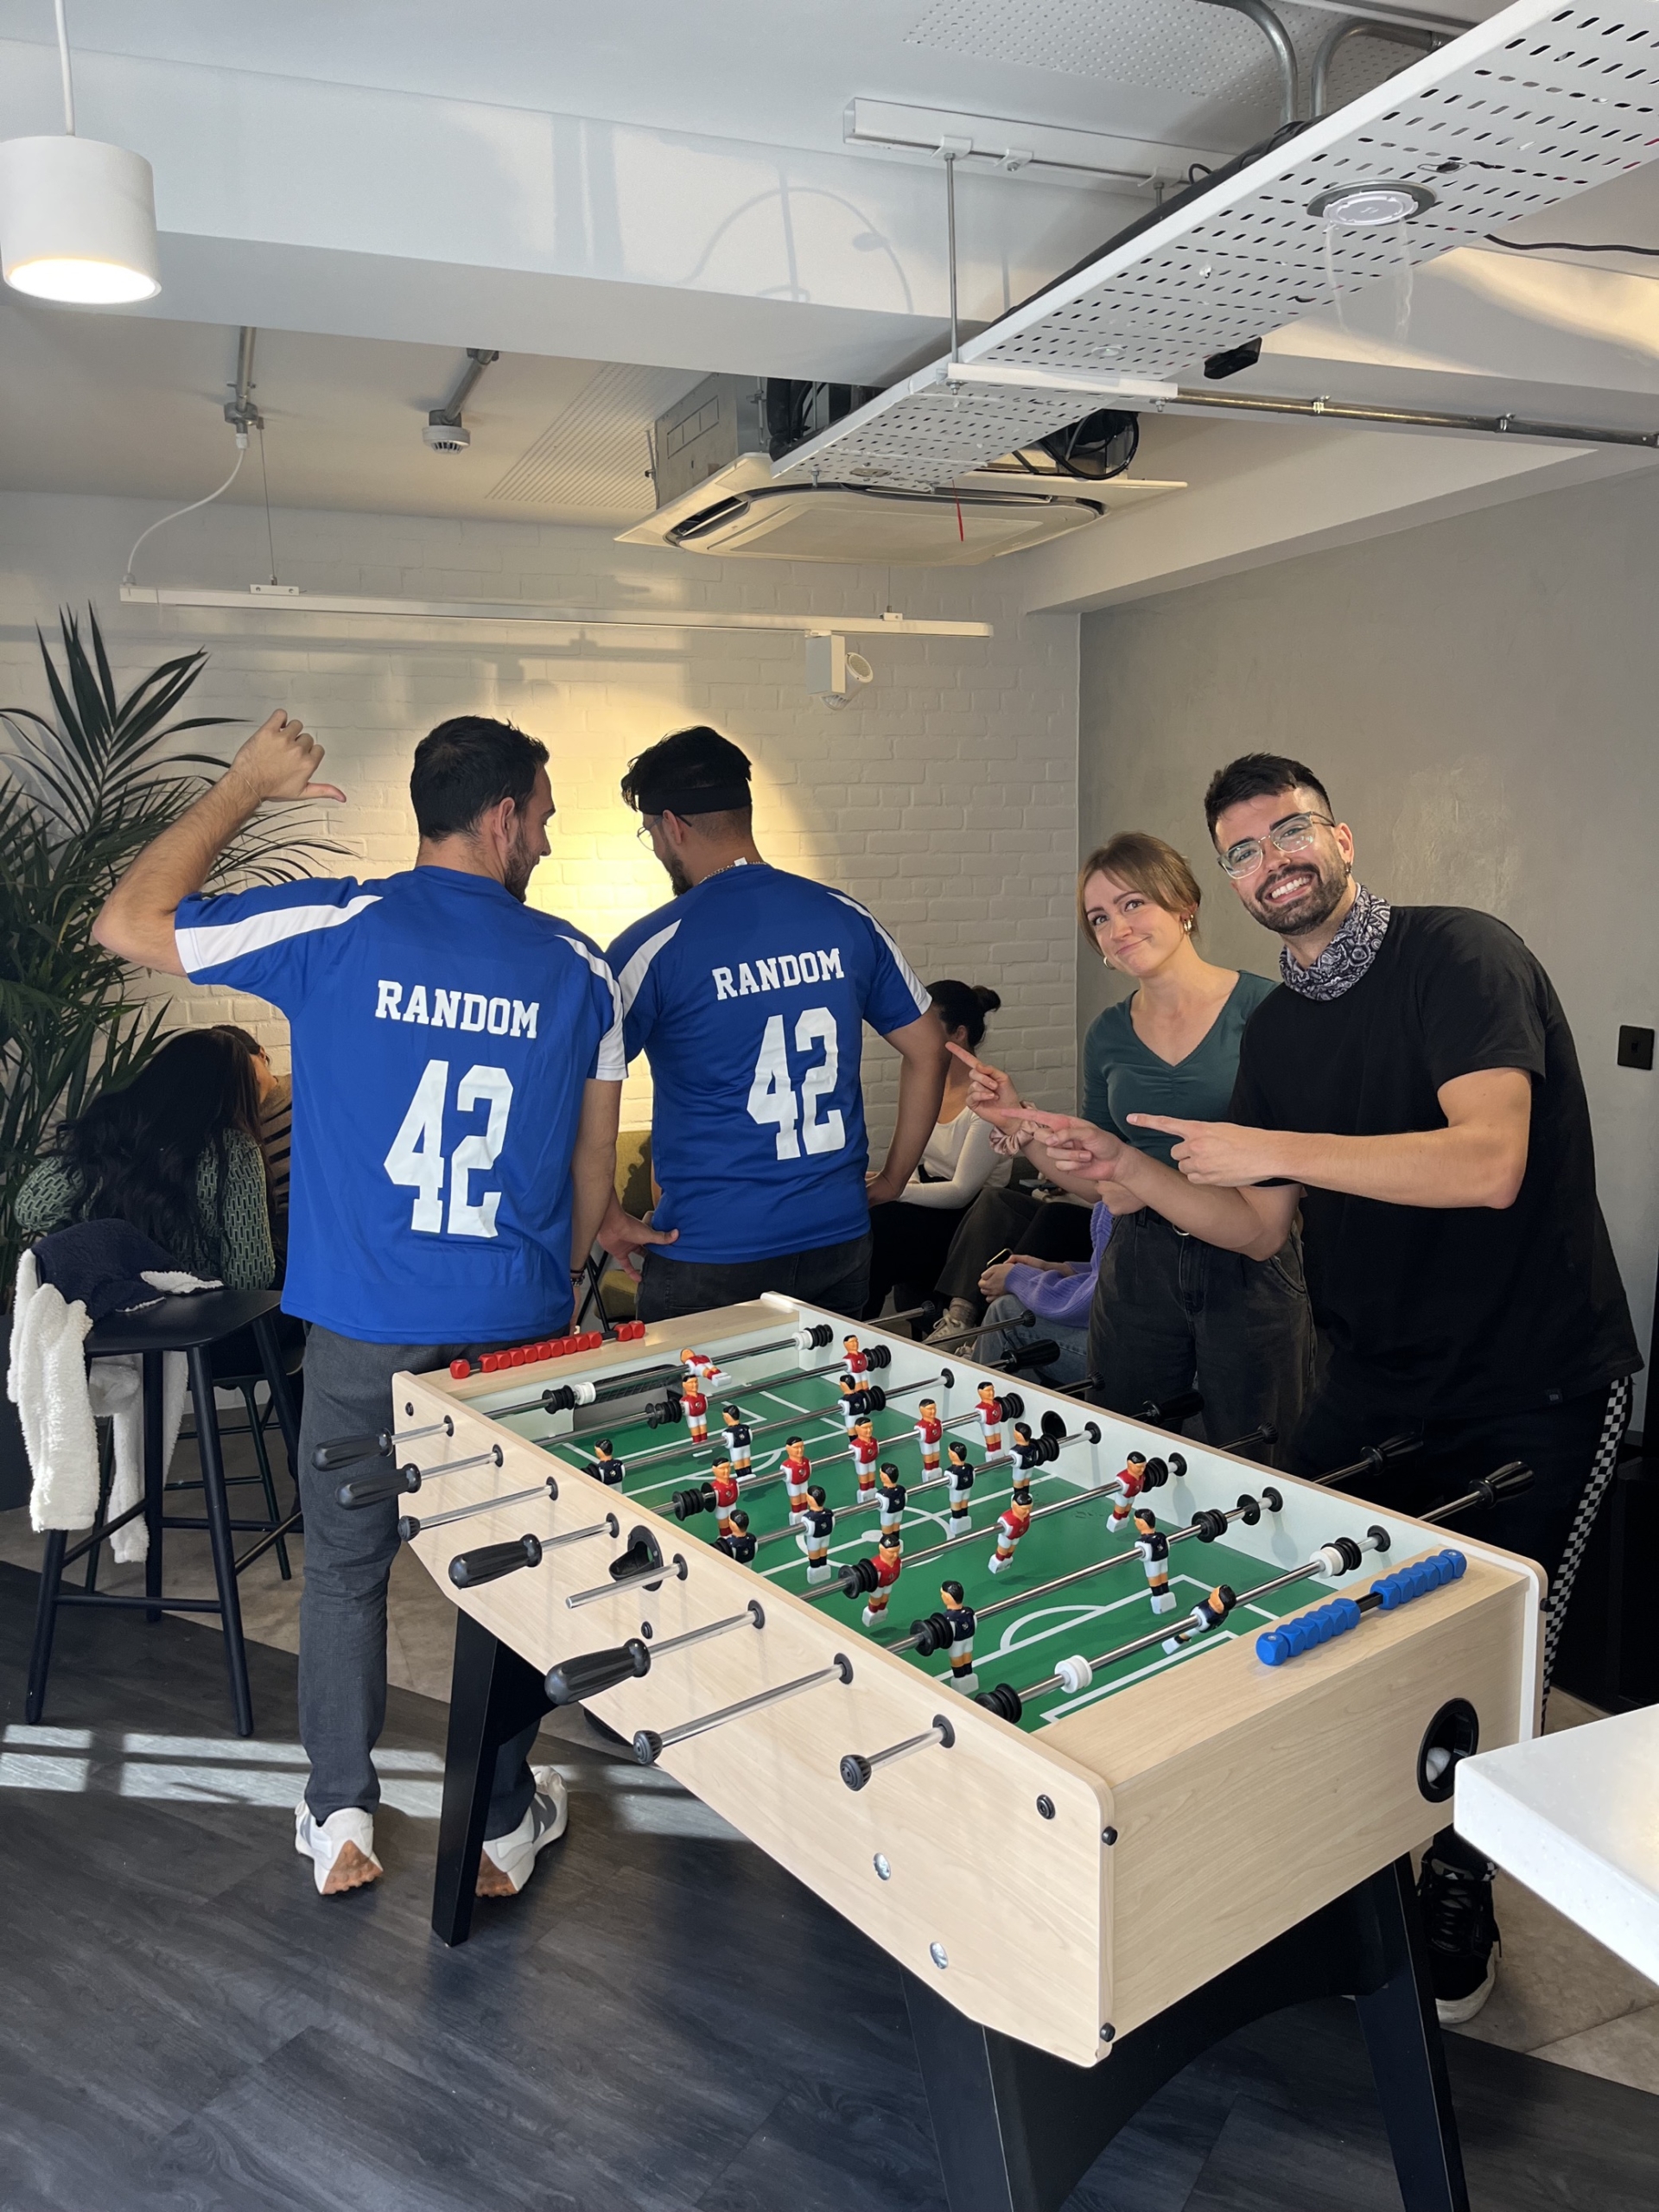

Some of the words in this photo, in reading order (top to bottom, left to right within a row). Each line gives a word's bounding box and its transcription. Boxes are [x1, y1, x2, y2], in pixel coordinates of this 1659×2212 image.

[375, 979, 540, 1039] RANDOM
[712, 948, 845, 1001] RANDOM
[747, 1007, 846, 1160] 42
[384, 1059, 514, 1238] 42
